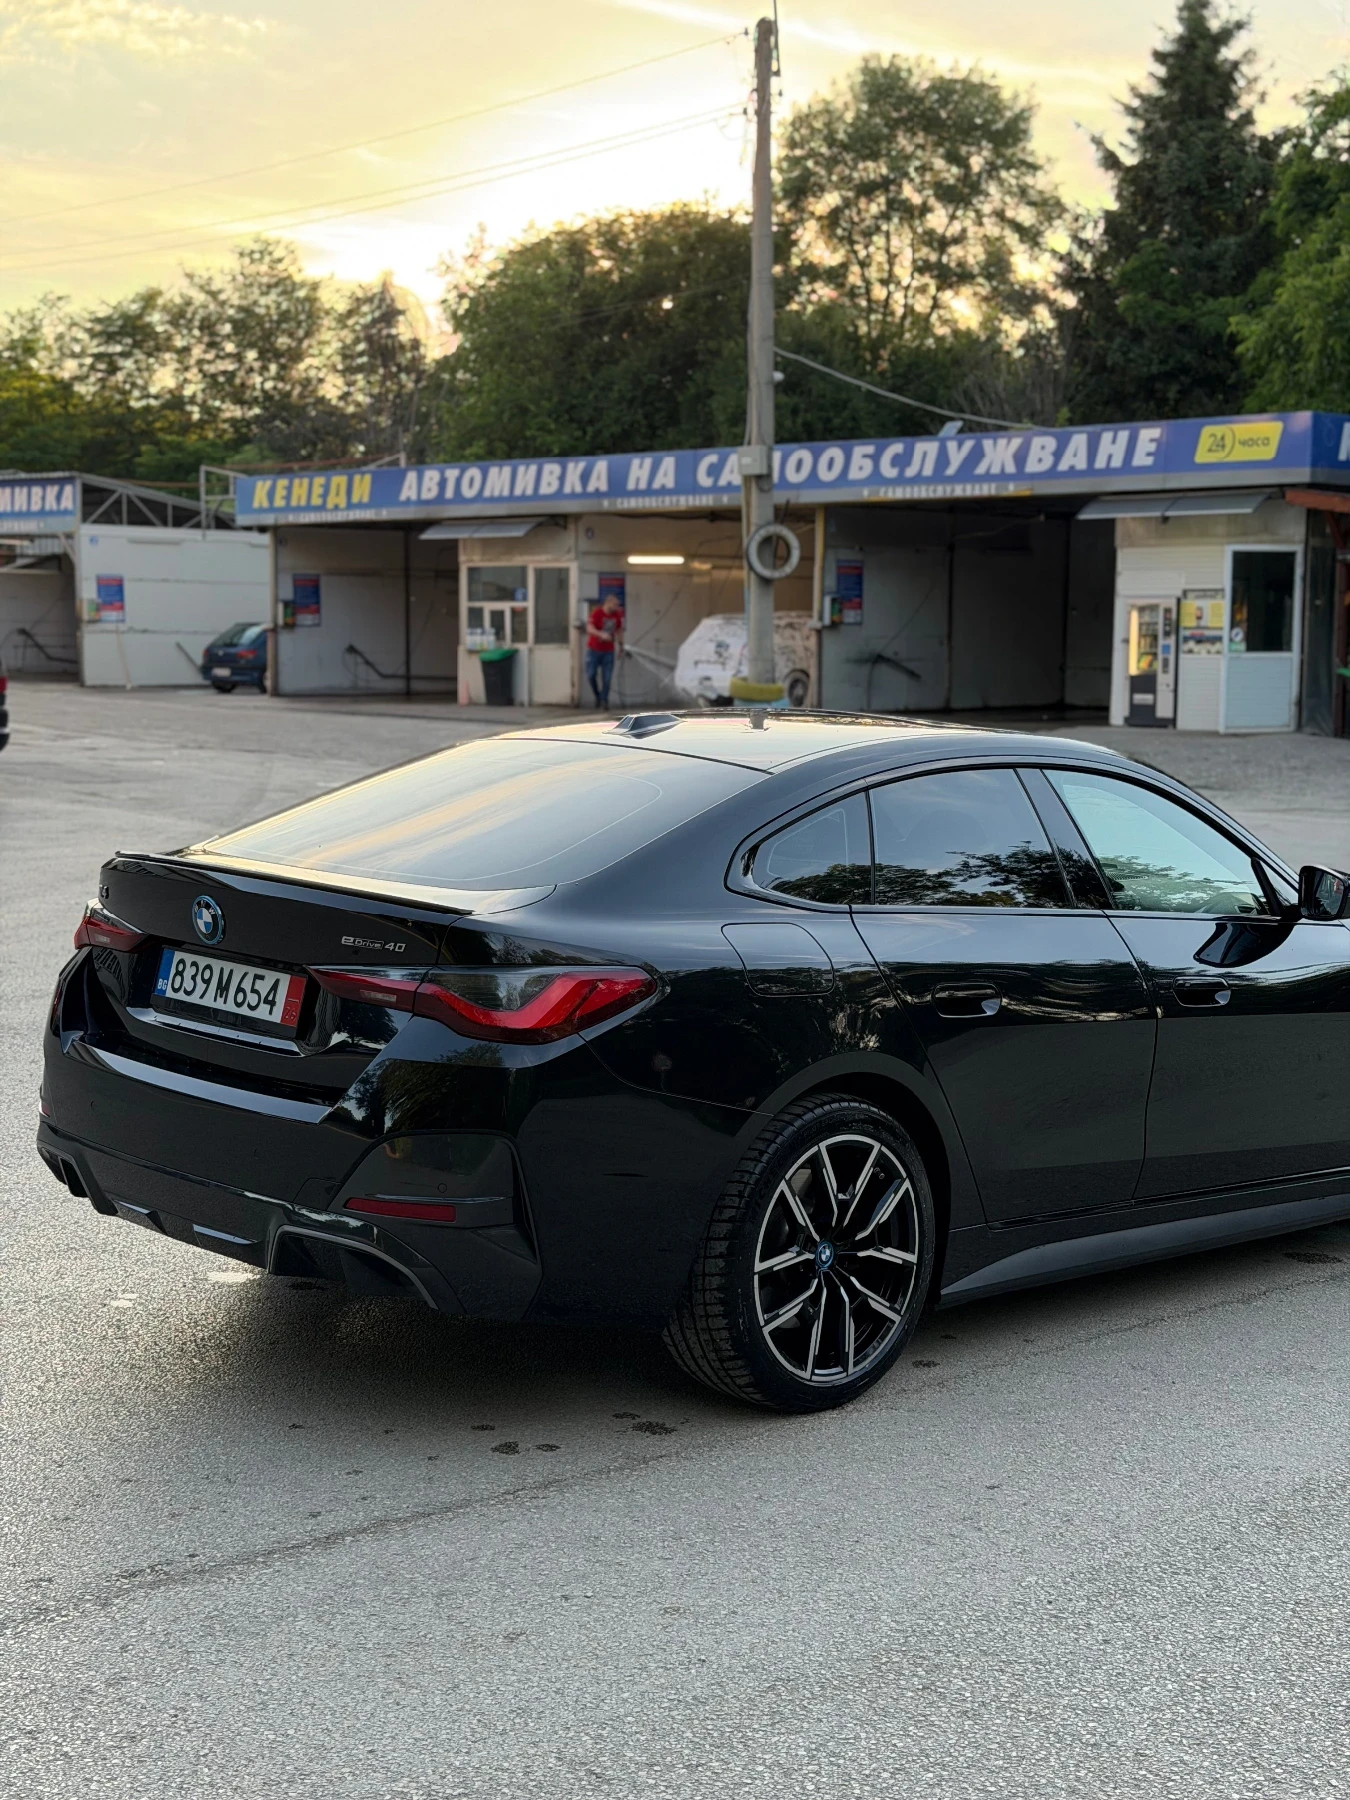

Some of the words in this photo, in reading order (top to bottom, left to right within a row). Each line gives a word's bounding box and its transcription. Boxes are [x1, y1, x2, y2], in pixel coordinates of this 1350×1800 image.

[1206, 433, 1226, 453] 24
[1238, 436, 1271, 448] часа
[252, 473, 372, 510] КЕНЕДИ
[399, 459, 609, 502] АВТОМИВКА
[626, 456, 676, 491] НА
[696, 427, 1162, 488] САООБСЛУЖВАНЕ
[384, 942, 407, 953] 40
[157, 979, 168, 992] BG
